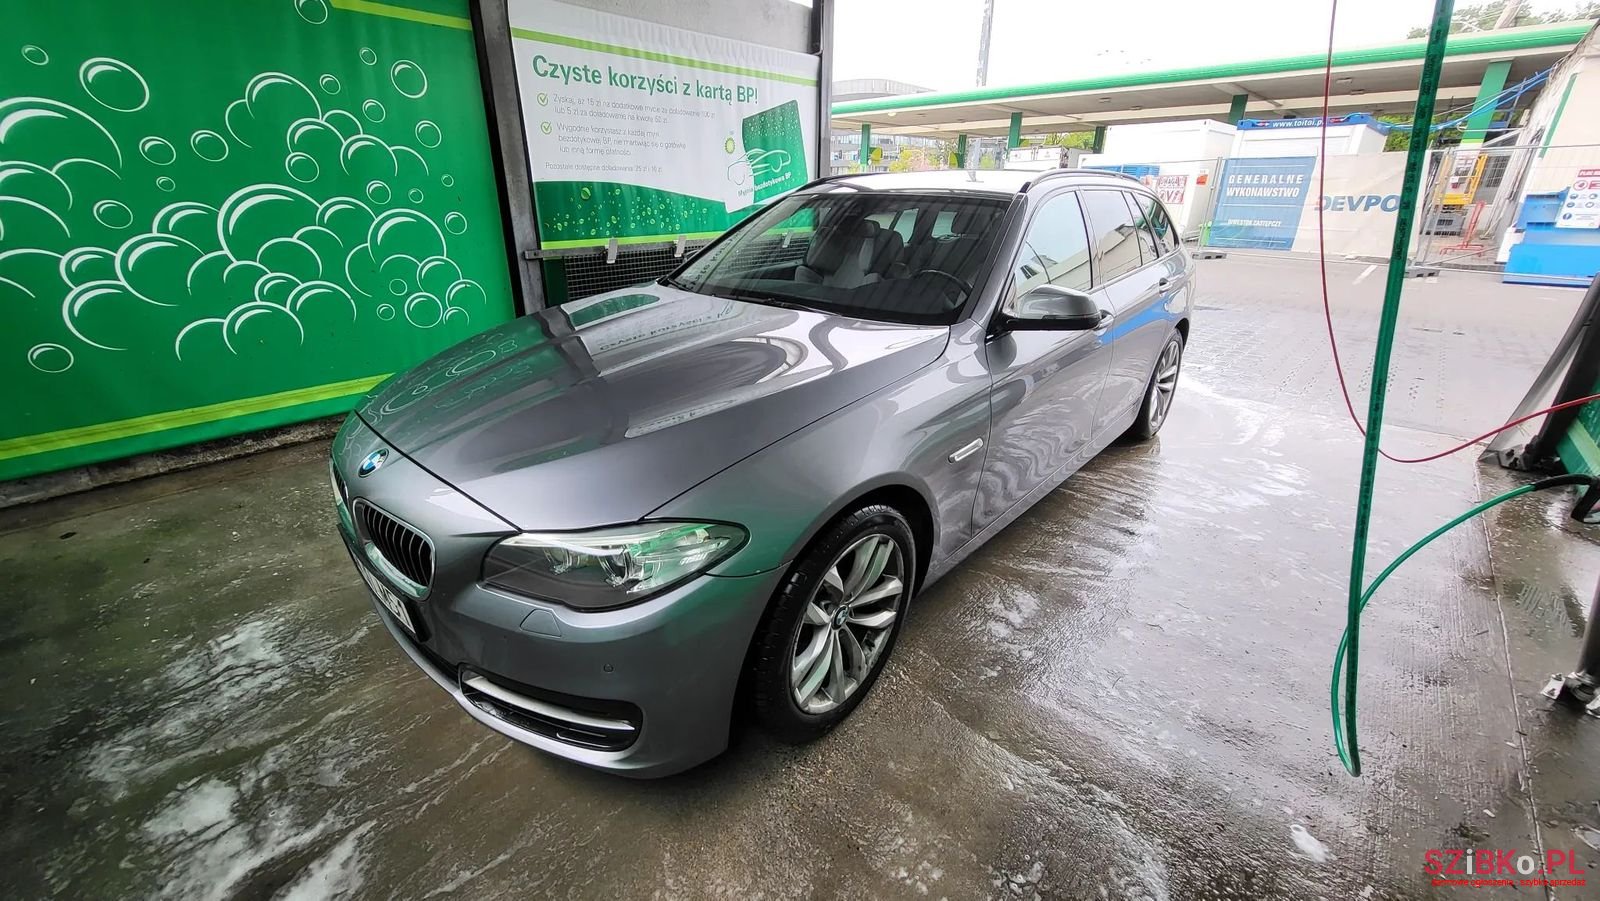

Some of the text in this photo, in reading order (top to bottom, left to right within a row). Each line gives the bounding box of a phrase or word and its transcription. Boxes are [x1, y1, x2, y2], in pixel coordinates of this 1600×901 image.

[532, 55, 758, 105] Czyste korzyści z kartą BP!
[554, 106, 565, 114] lub
[567, 107, 572, 115] 5
[556, 121, 590, 133] Wygodnie
[591, 125, 621, 135] korzystasz
[558, 135, 601, 146] bezdotykowej
[559, 145, 569, 153] lub
[754, 176, 785, 191] bezdotykowa
[784, 171, 792, 180] BP
[1228, 174, 1304, 184] GENERALNE
[1226, 187, 1300, 198] WYKONAWSTWO
